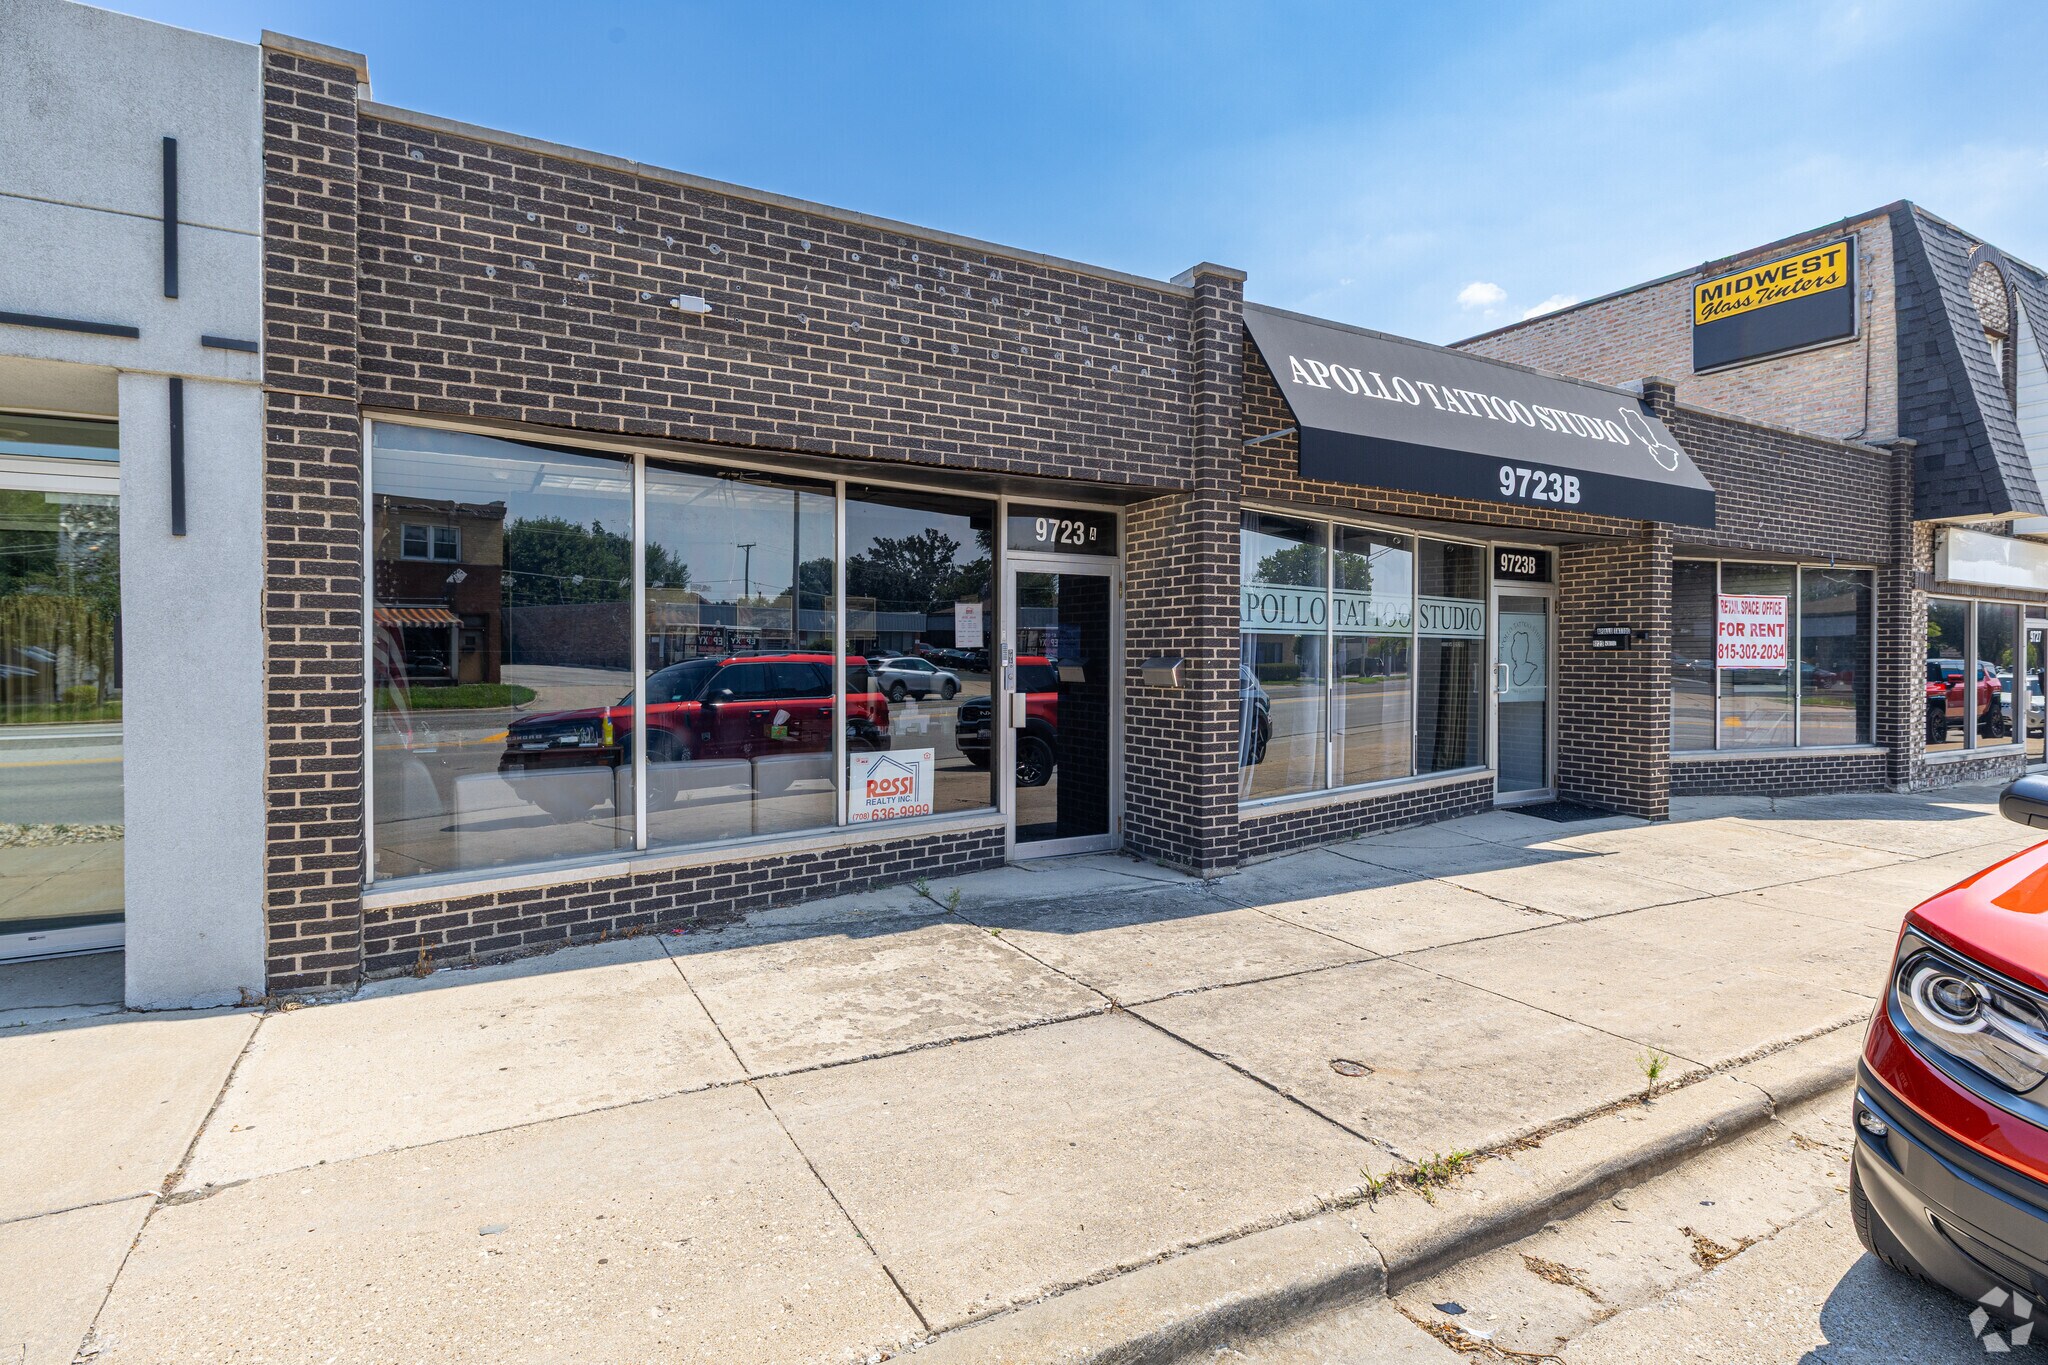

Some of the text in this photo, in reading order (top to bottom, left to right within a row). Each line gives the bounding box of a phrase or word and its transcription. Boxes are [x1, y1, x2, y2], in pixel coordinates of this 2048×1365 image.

[1701, 249, 1841, 303] MIDWEST
[1701, 271, 1840, 320] Glass Tinters
[1288, 355, 1630, 445] APOLLO TATTOO STUDIO
[1499, 465, 1581, 504] 9723B
[1035, 517, 1085, 545] 9723
[1500, 553, 1536, 574] 9723B
[1333, 599, 1412, 628] TATTOO
[1420, 603, 1482, 631] STUDIO
[1741, 600, 1760, 615] SPACE
[1762, 601, 1782, 615] OFFICE
[1719, 622, 1785, 637] FOR RENT
[2030, 630, 2042, 643] 9727
[1718, 643, 1785, 659] 815-302-2034
[866, 776, 914, 798] ROSSI
[866, 795, 913, 806] REALTY INC.
[852, 803, 930, 821] (708) 636-9999
